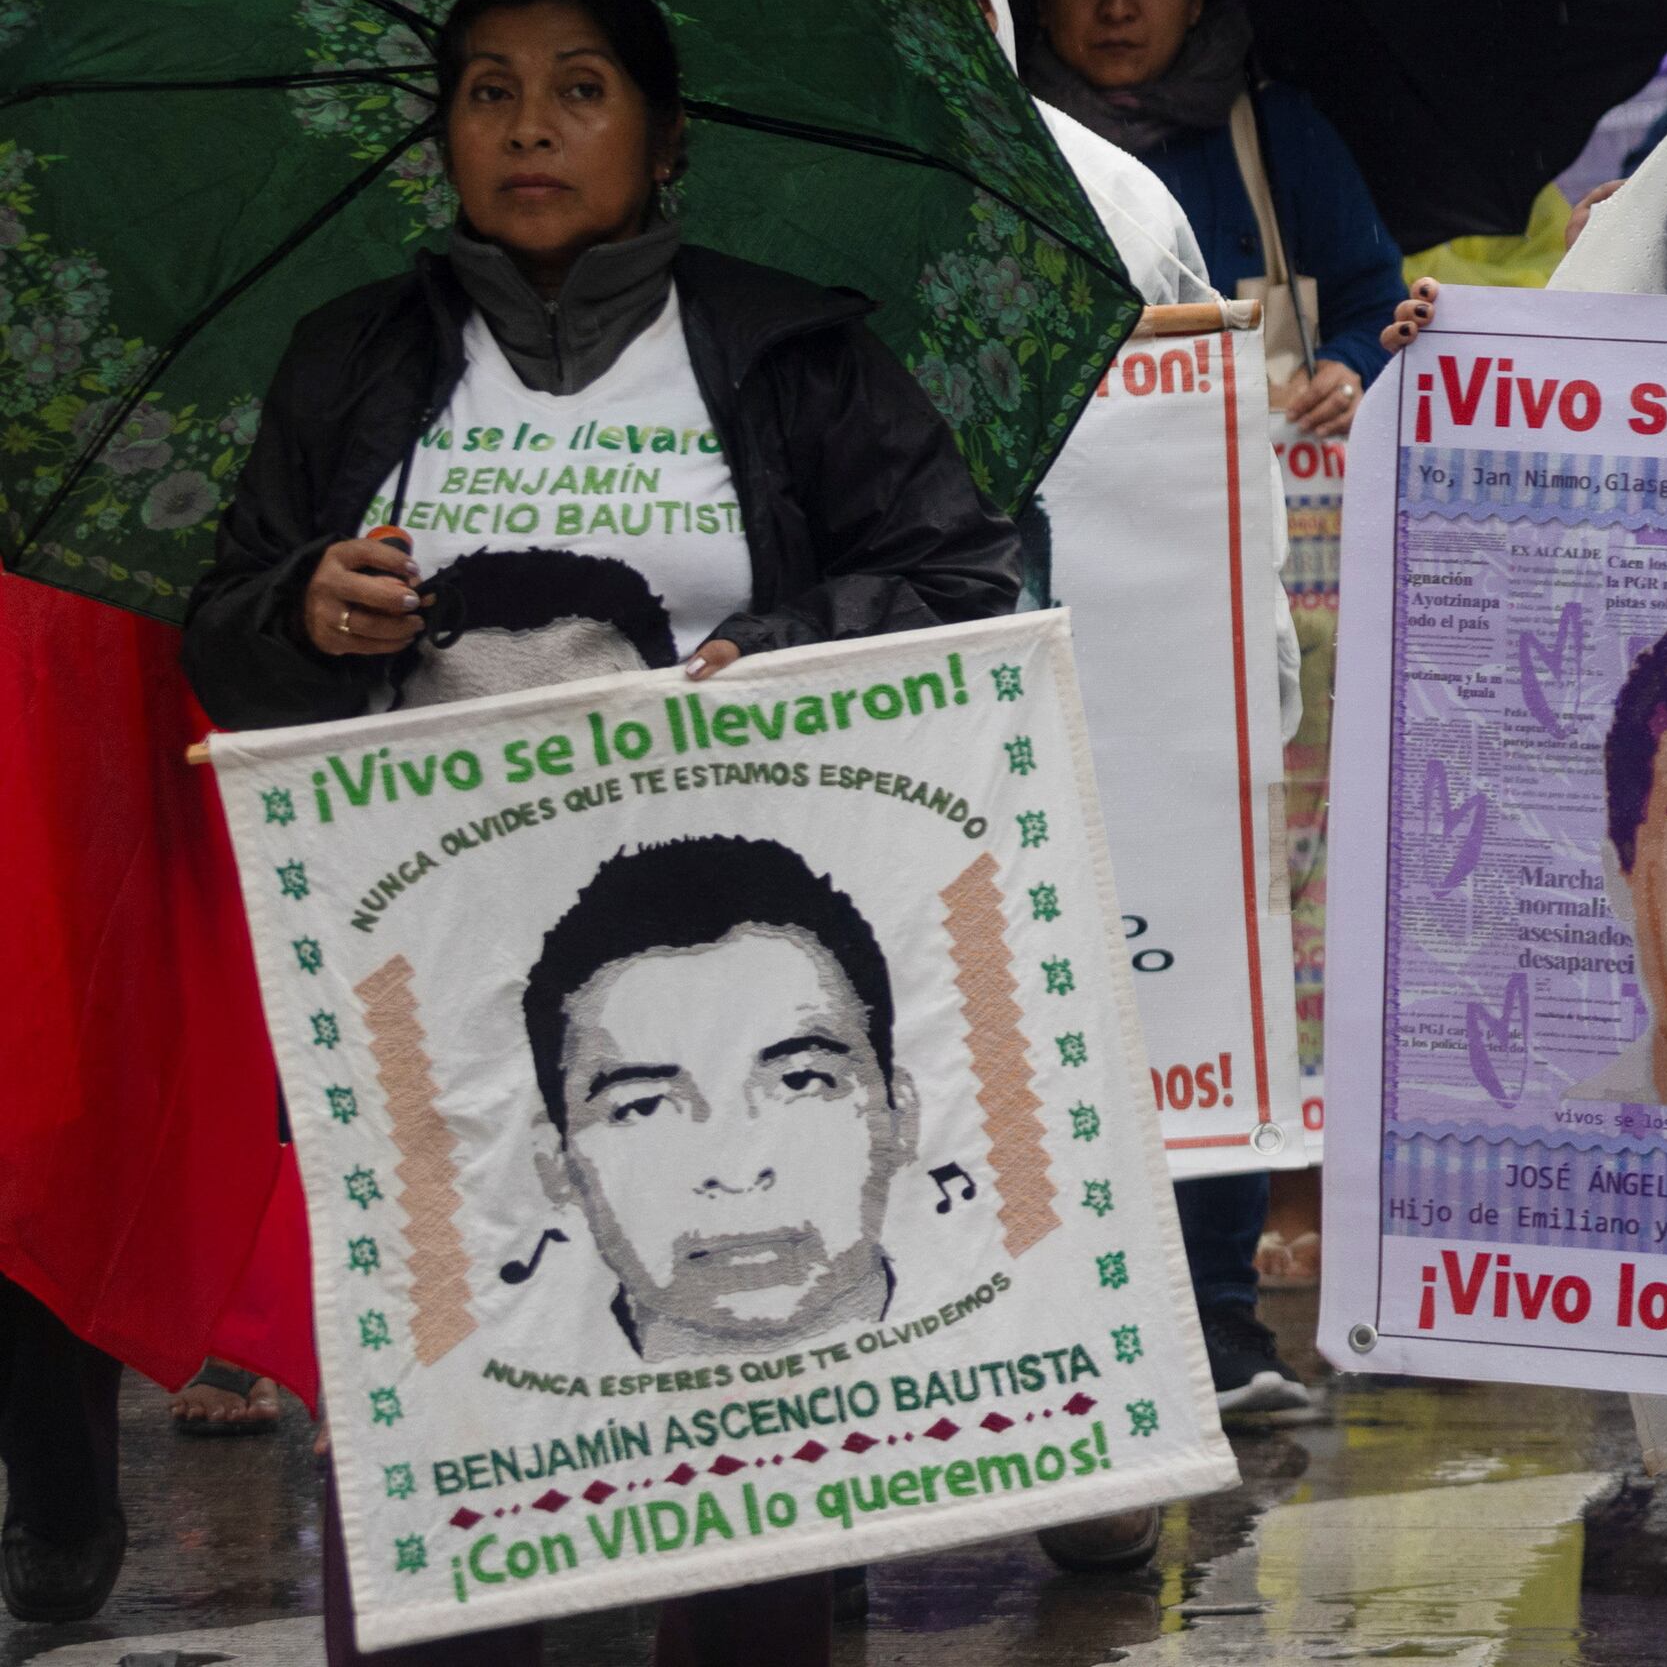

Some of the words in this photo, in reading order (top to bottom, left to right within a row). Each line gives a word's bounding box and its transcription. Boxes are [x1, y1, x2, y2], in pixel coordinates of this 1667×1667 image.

[1415, 355, 1602, 443] ¡Vivo
[462, 427, 504, 452] se
[512, 421, 557, 452] lo
[440, 462, 661, 496] BENJAMÍN
[1419, 465, 1455, 488] Yo,
[1473, 467, 1511, 486] Jan
[555, 500, 747, 537] BAUTIST
[1511, 545, 1530, 557] EX
[1534, 546, 1602, 560] ALCALDE
[1607, 555, 1644, 570] Caen
[1412, 592, 1500, 611] Ayotzinapa
[1605, 596, 1646, 613] pistas
[1458, 614, 1491, 631] país
[1457, 686, 1496, 699] Iguala
[312, 748, 483, 822] ¡Vivo
[504, 733, 575, 784] se
[588, 712, 652, 766] lo
[664, 653, 969, 755] llevaron!
[351, 850, 438, 933] NUNCA
[440, 797, 557, 857] OLVIDES
[564, 777, 624, 813] QUE
[632, 768, 667, 796] TE
[674, 761, 811, 792] ESTAMOS
[818, 764, 988, 840] ESPERANDO
[1519, 865, 1606, 892] Marcha
[1518, 923, 1635, 949] asesinados
[1554, 1110, 1604, 1127] vivos
[1614, 1115, 1634, 1128] se
[1504, 1162, 1571, 1192] JOSÉ
[1389, 1198, 1452, 1228] Hijo
[1469, 1202, 1500, 1226] de
[1518, 1205, 1641, 1236] Emiliano
[1418, 1249, 1593, 1331] ¡Vivo
[482, 1358, 590, 1398] NUNCA
[599, 1365, 733, 1398] ESPERES
[739, 1354, 806, 1383] QUE
[808, 1343, 852, 1370] TE
[855, 1270, 1013, 1356] OLVIDEMOS
[432, 1418, 651, 1499] BENJAMÍN
[662, 1379, 880, 1454] ASCENCIO
[894, 1342, 1102, 1413] BAUTISTA
[452, 1527, 578, 1603] ¡Con
[586, 1489, 737, 1561] VIDA
[743, 1482, 798, 1535] lo
[814, 1420, 1113, 1529] queremos!
